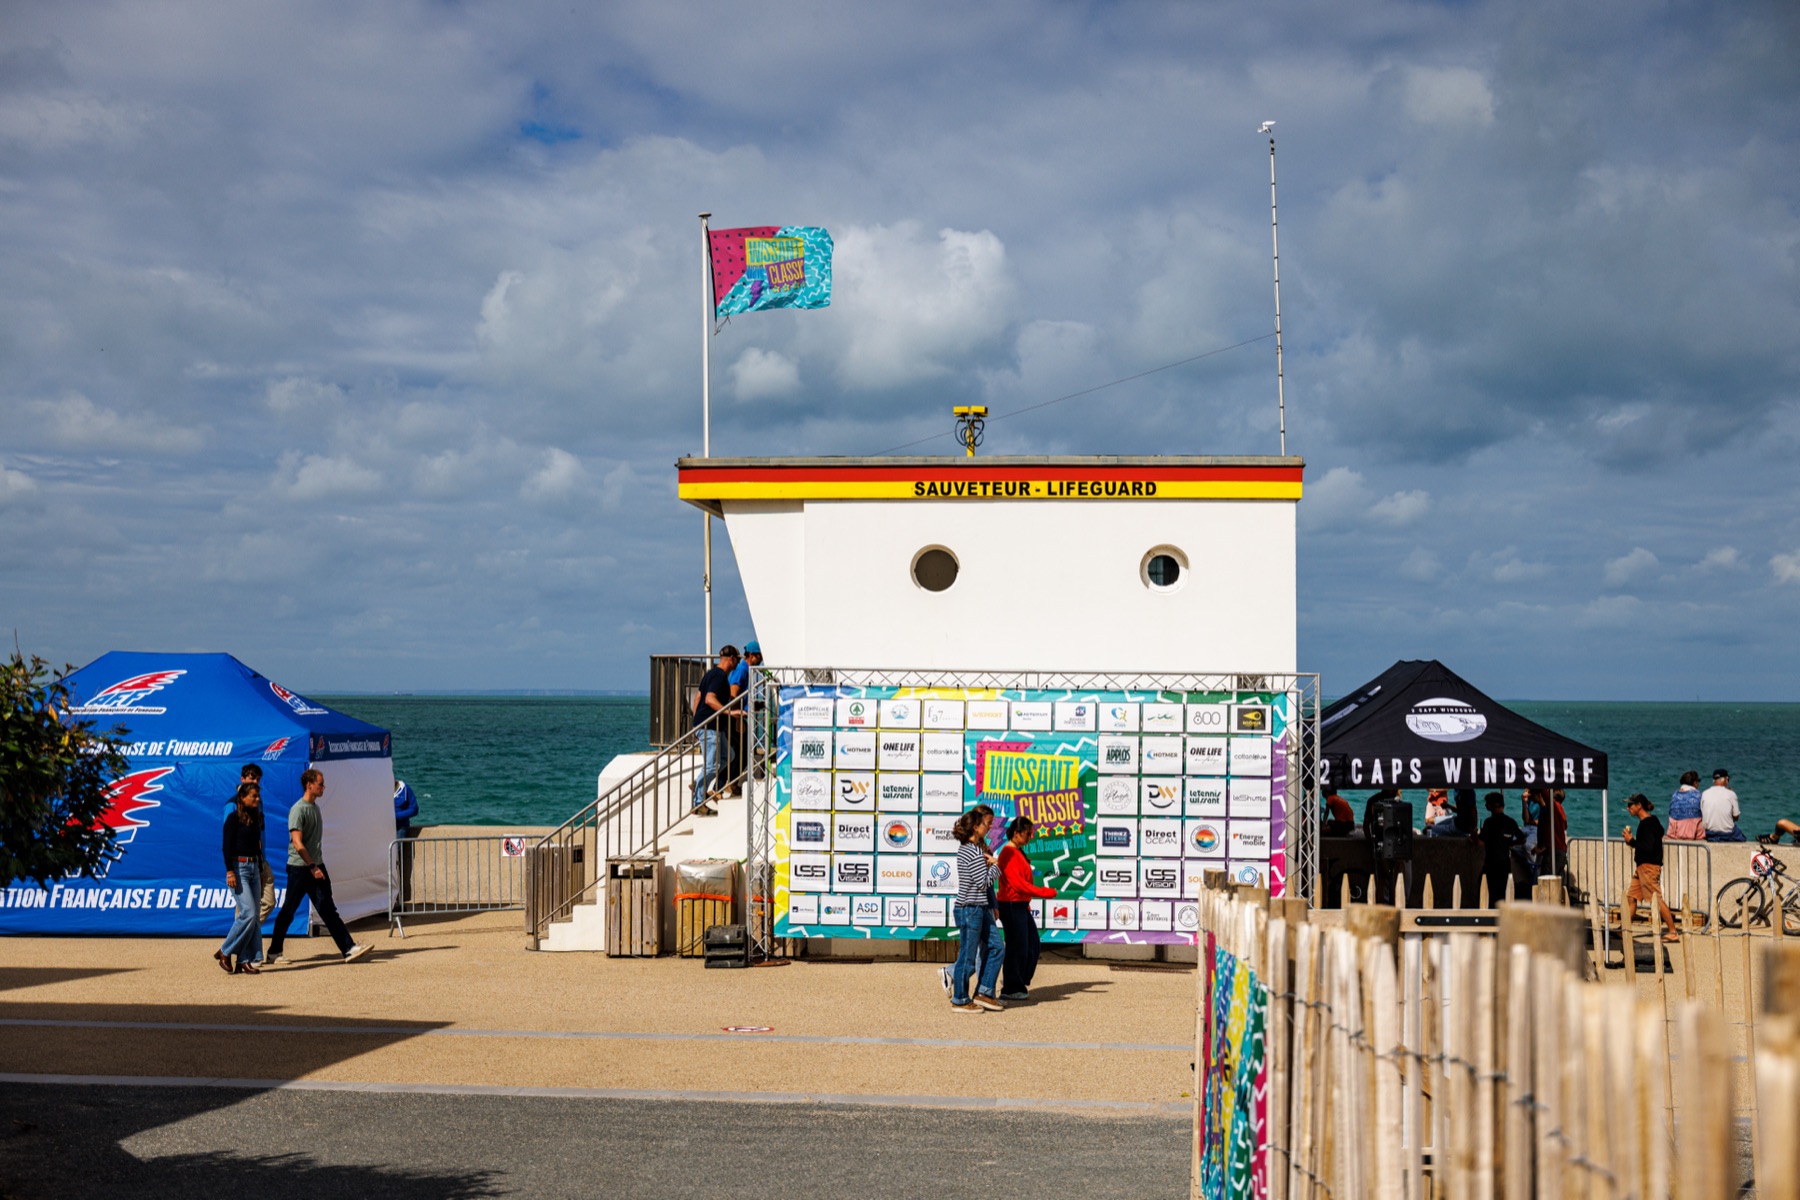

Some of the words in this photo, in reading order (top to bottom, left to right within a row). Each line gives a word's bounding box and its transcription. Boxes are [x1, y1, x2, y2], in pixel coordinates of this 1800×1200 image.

[748, 240, 800, 262] WISSANT
[914, 481, 1030, 496] SAUVETEUR
[1047, 481, 1157, 496] LIFEGUARD
[148, 742, 166, 756] DE
[166, 739, 233, 756] FUNBOARD
[883, 743, 899, 751] ONE
[900, 743, 915, 751] LIFE
[1190, 748, 1206, 756] ONE
[1207, 748, 1222, 756] LIFE
[990, 755, 1074, 793] WISSANT
[1319, 758, 1330, 785] 2
[1352, 758, 1422, 785] CAPS
[1443, 757, 1594, 784] WINDSURF
[1019, 791, 1080, 824] CLASSIC
[839, 825, 869, 833] Direct
[1239, 833, 1263, 841] Energie
[795, 865, 826, 877] LSS
[838, 863, 869, 876] LSS
[1145, 868, 1176, 881] LSS
[1100, 870, 1132, 883] LSS
[50, 884, 155, 911] FRANÇAISE
[157, 888, 183, 908] DE
[856, 903, 879, 913] ASD
